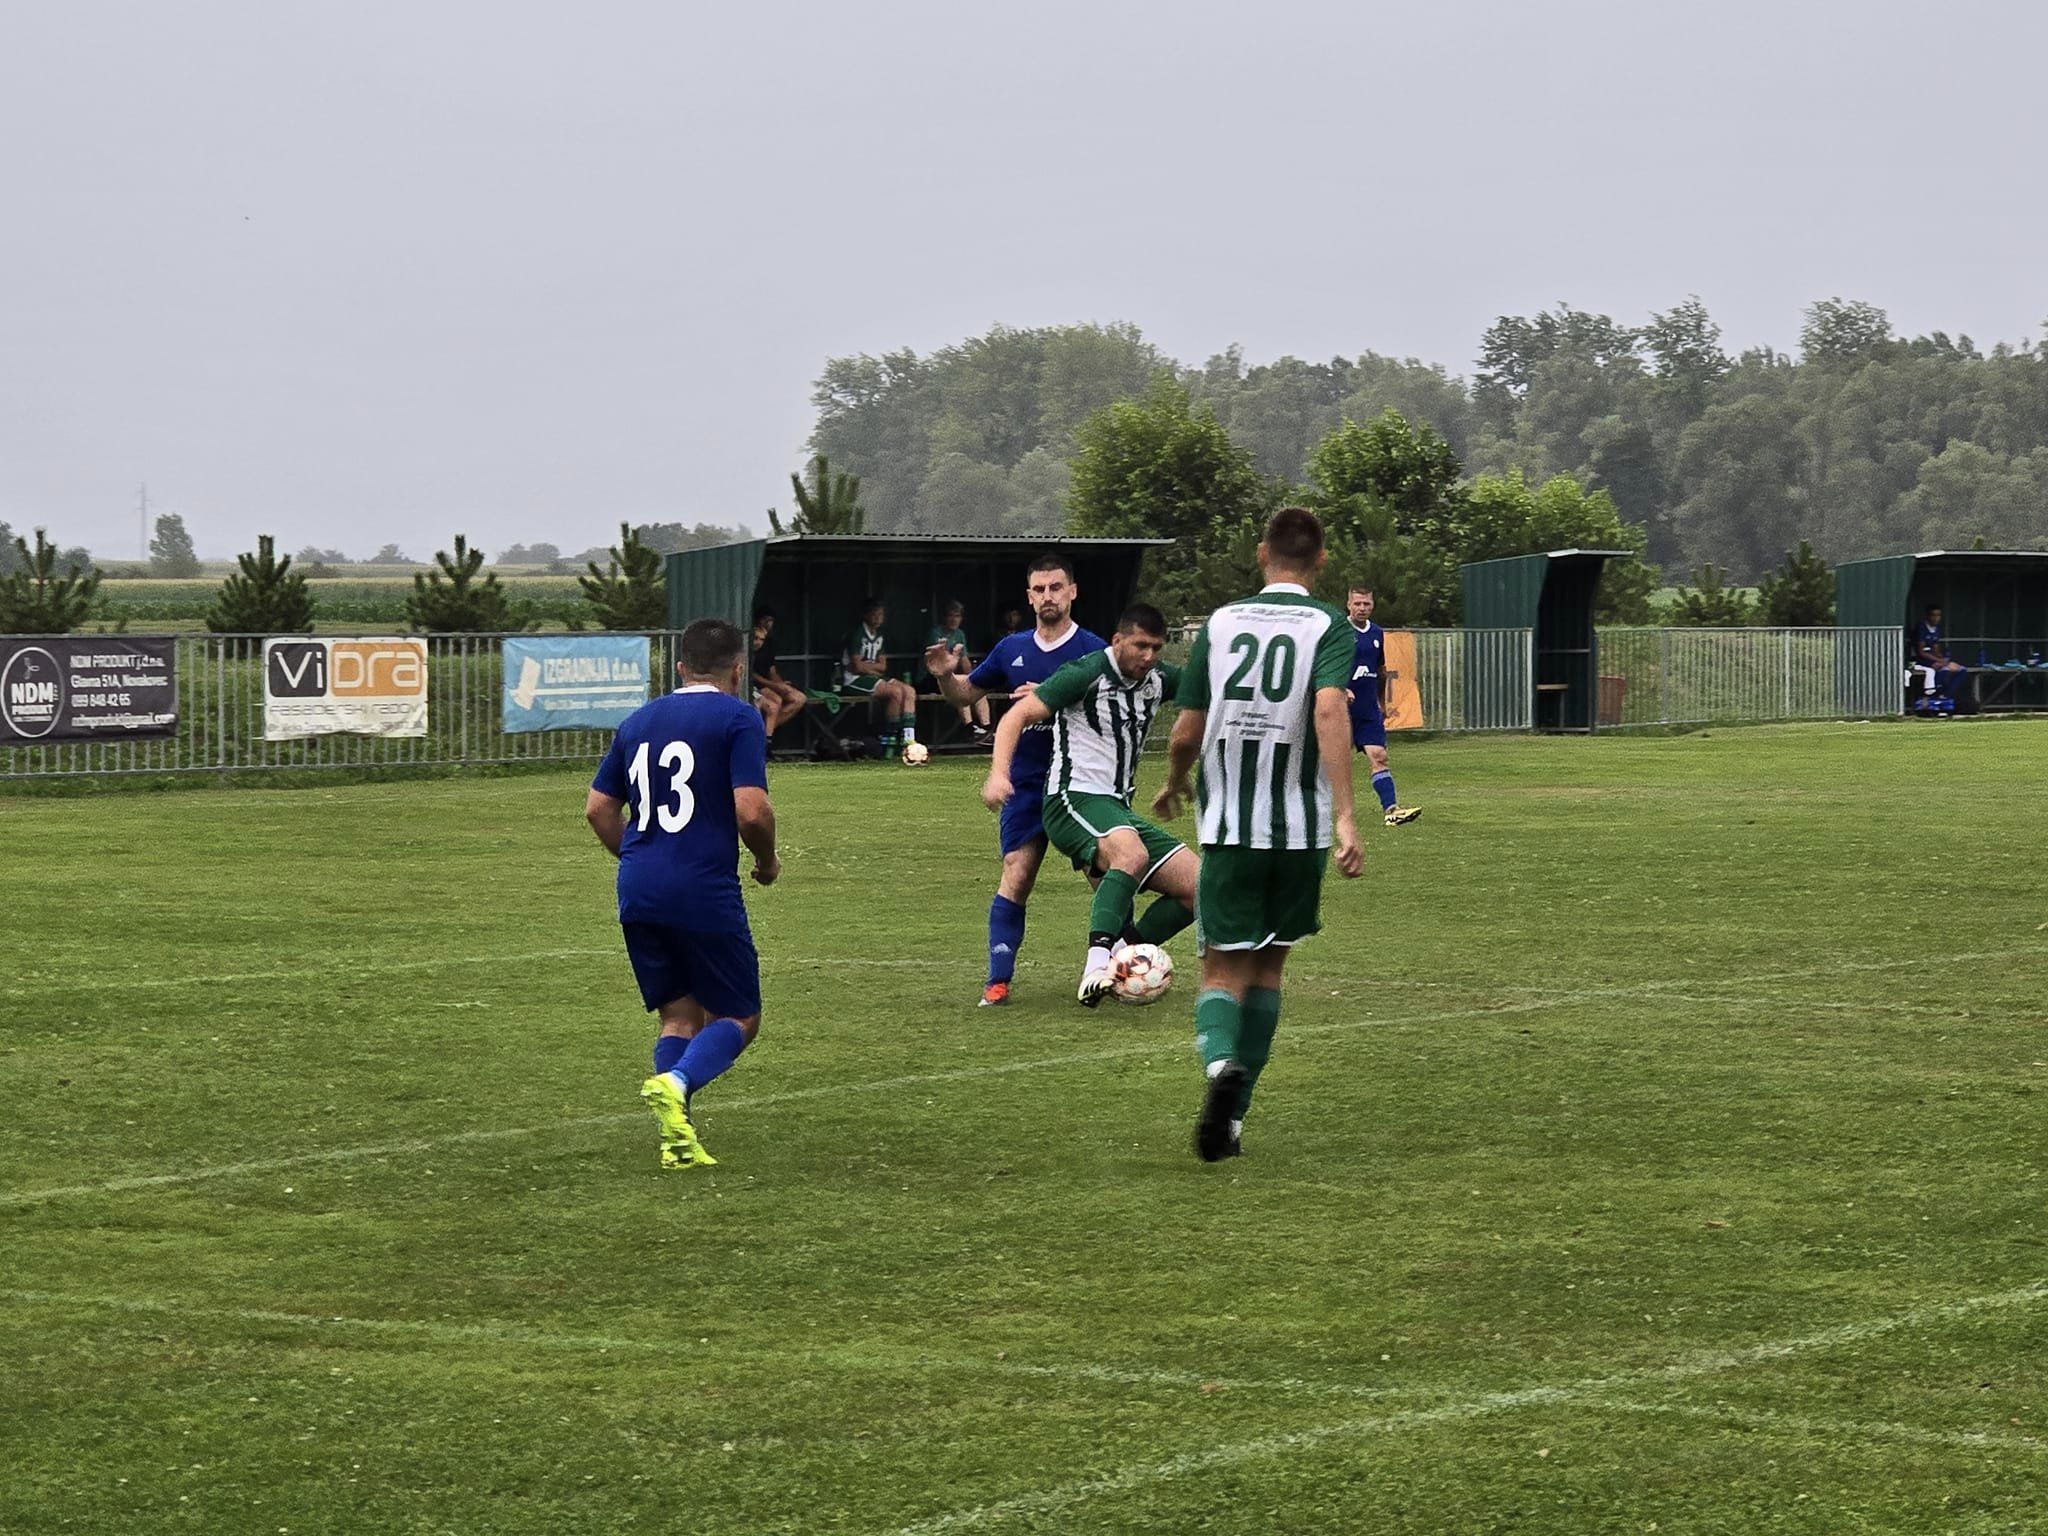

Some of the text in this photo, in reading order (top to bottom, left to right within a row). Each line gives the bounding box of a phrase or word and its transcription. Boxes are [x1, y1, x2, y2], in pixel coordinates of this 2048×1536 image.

[71, 655, 91, 668] NDM
[1223, 632, 1296, 703] 20
[11, 682, 54, 704] NDM
[12, 704, 54, 715] PRODUKT
[628, 741, 695, 834] 13
